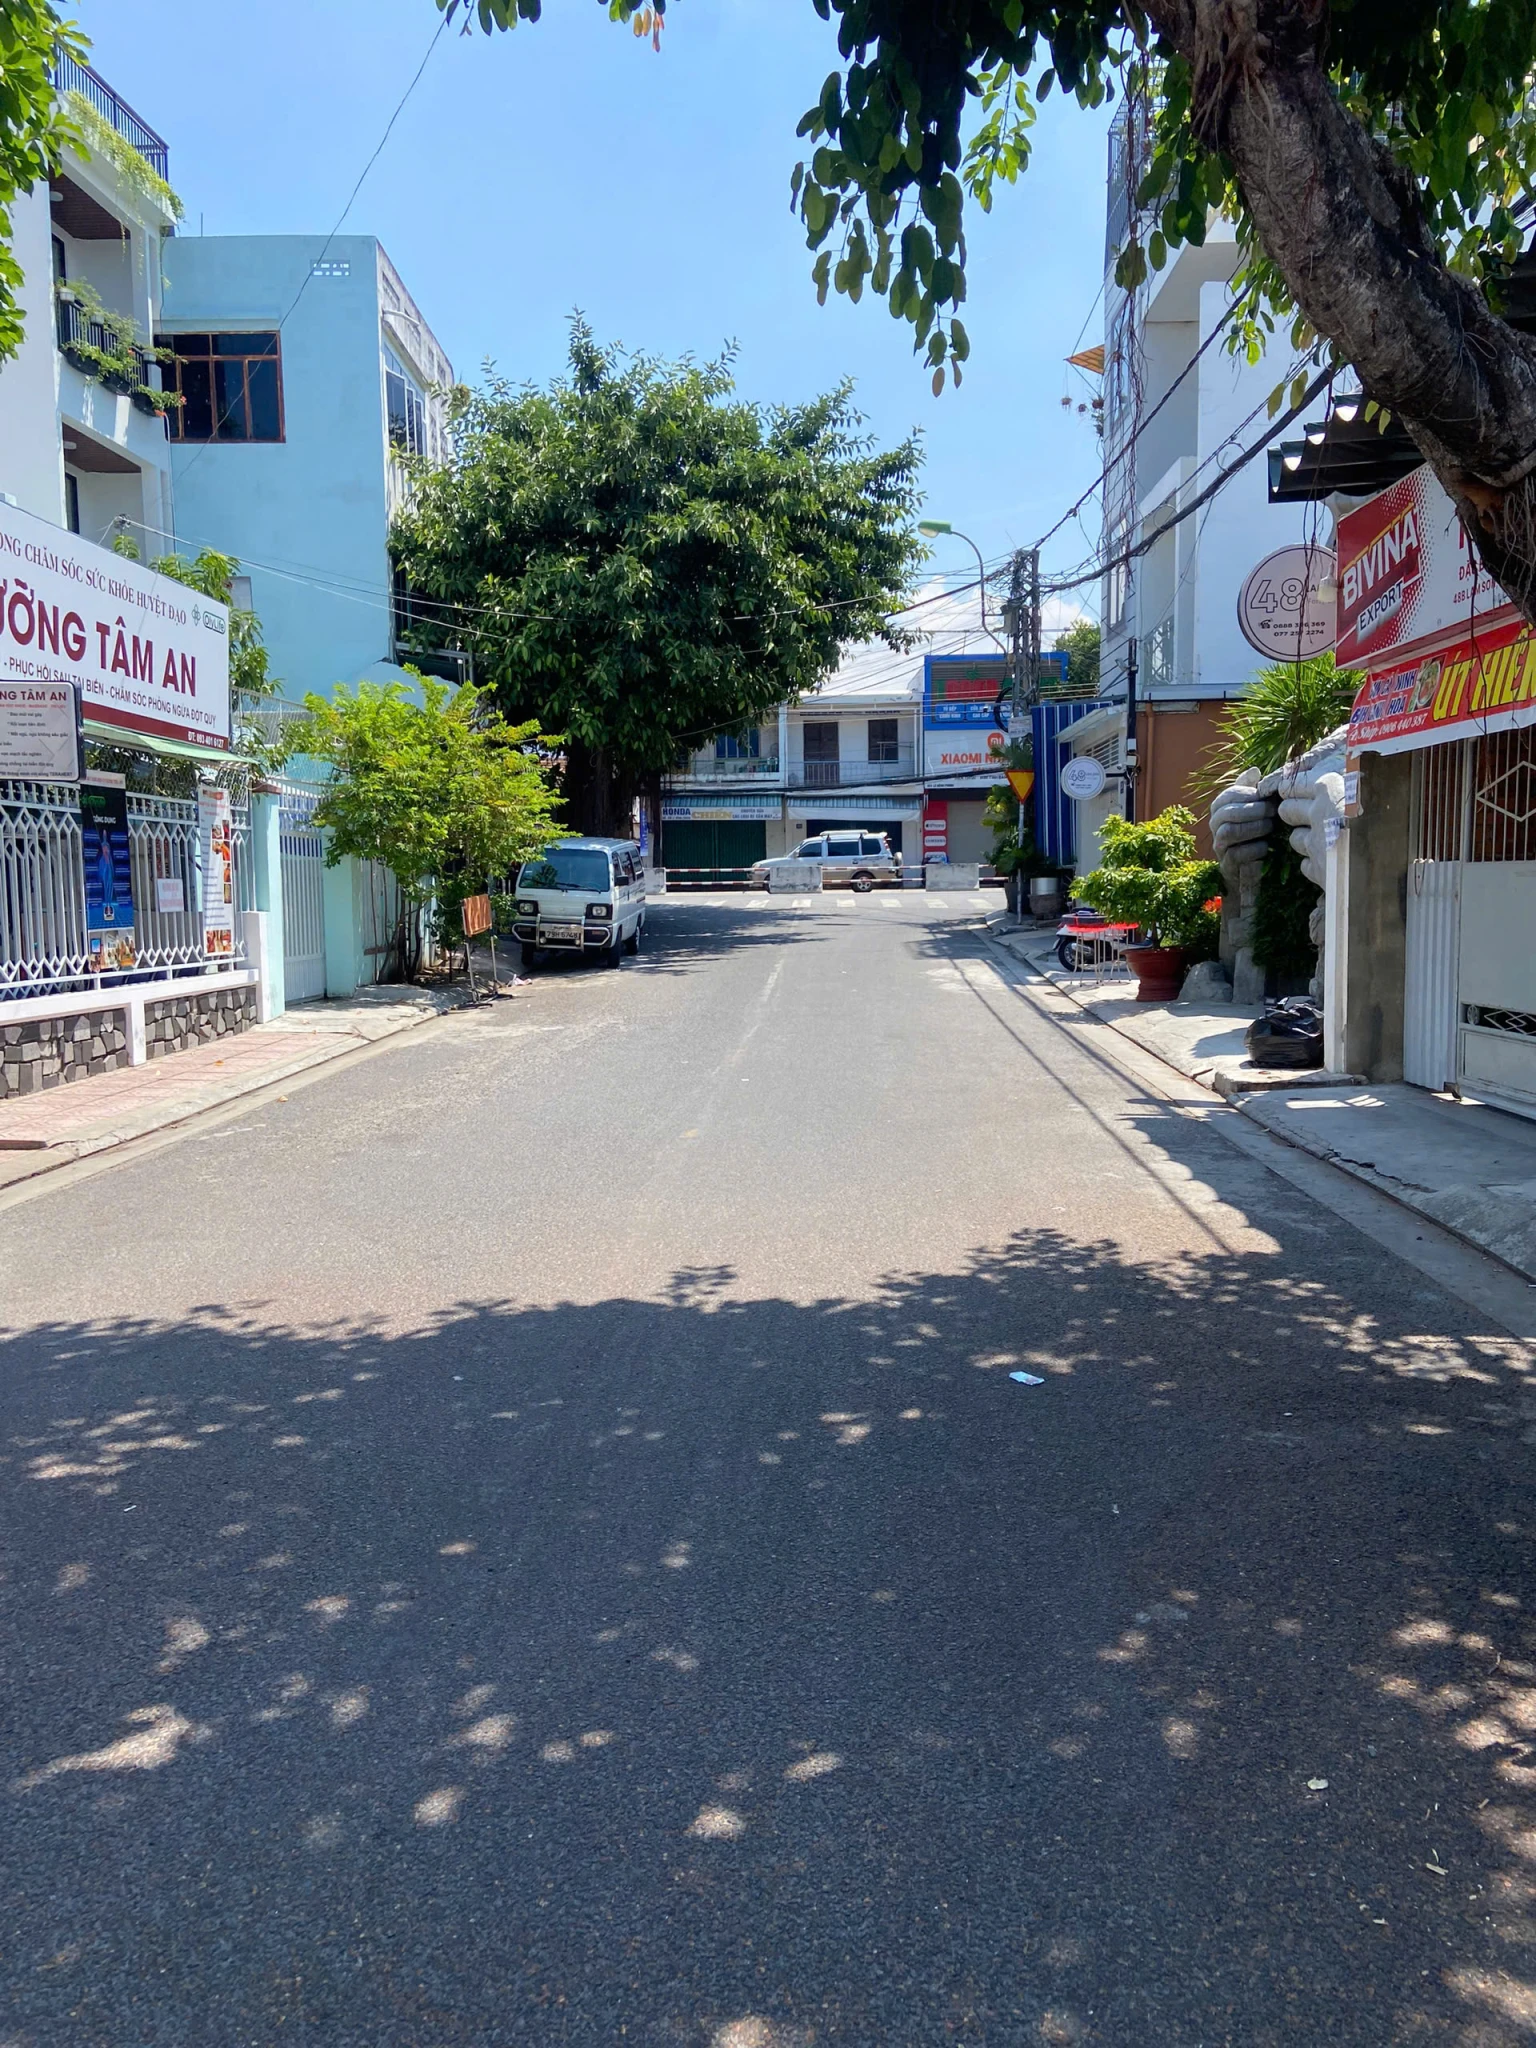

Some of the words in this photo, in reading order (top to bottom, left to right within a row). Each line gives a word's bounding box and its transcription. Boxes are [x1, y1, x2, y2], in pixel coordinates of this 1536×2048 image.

[25, 543, 58, 573] CHĂM
[61, 557, 83, 583] SÓC
[85, 567, 106, 592] SỨC
[168, 605, 187, 626] ĐẠO
[1342, 510, 1419, 611] BIVINA
[1250, 577, 1304, 613] 48
[1359, 580, 1403, 631] EXPORT
[0, 578, 87, 661] ỠNG
[96, 615, 154, 684] TÂM
[162, 648, 196, 697] AN
[9, 656, 35, 678] PHỤC
[109, 684, 131, 704] CHĂM
[132, 692, 147, 706] SÓC
[20, 688, 46, 701] TÂM
[49, 691, 67, 701] AN
[1433, 651, 1478, 721] ÚT
[941, 753, 982, 765] XIAOMI
